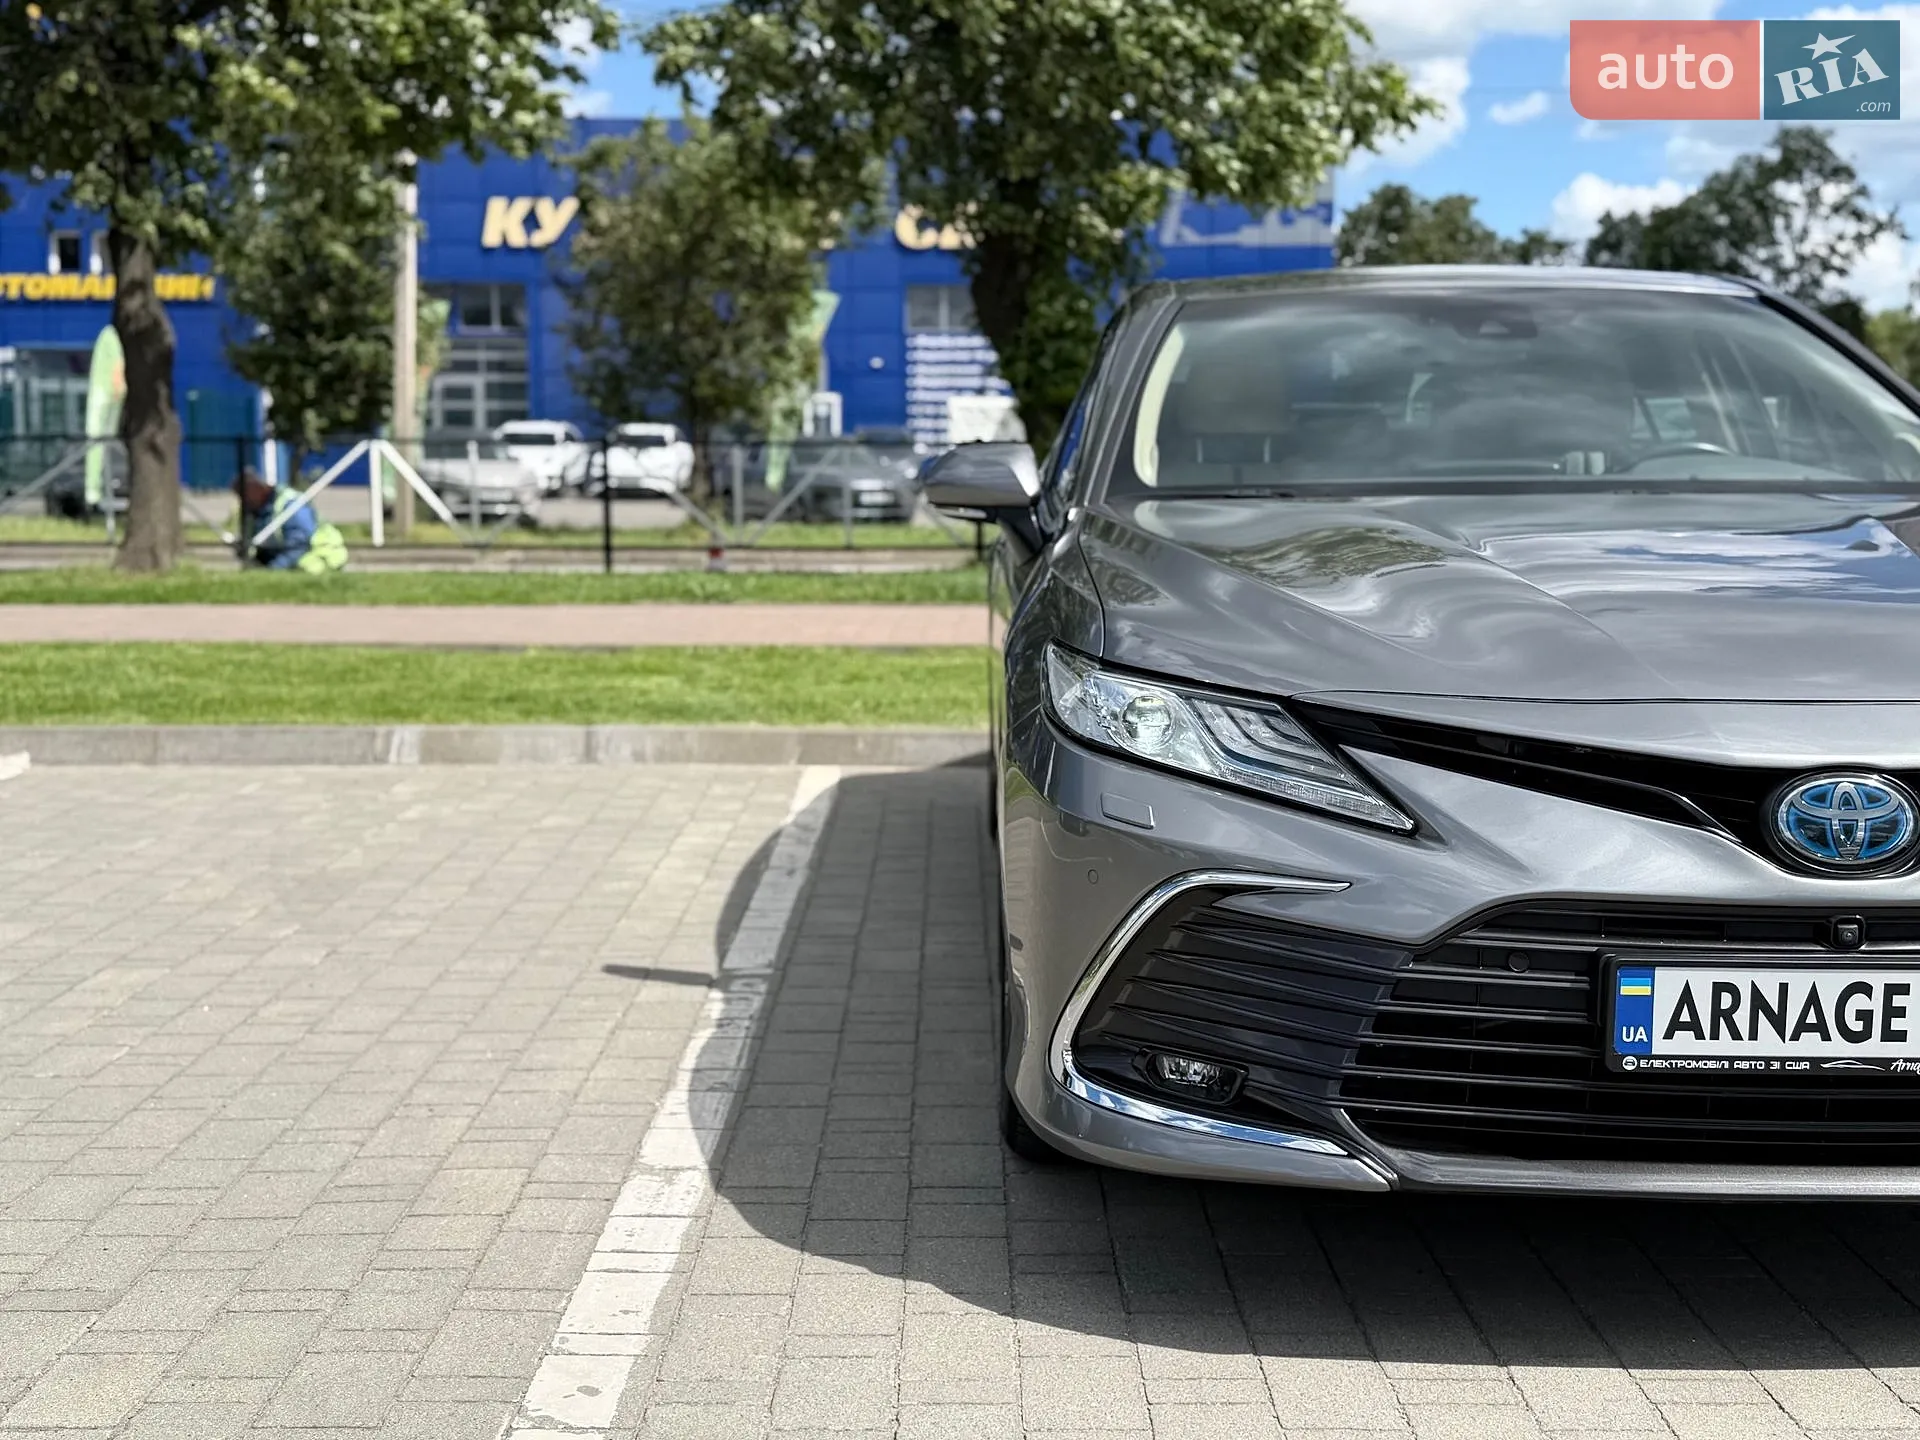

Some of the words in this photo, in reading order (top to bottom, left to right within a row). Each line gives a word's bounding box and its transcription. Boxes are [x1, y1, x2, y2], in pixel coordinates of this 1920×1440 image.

[1662, 979, 1911, 1044] ARNAGE
[1622, 1026, 1648, 1042] UA
[1733, 1060, 1765, 1070] АВТО
[1785, 1061, 1811, 1070] США
